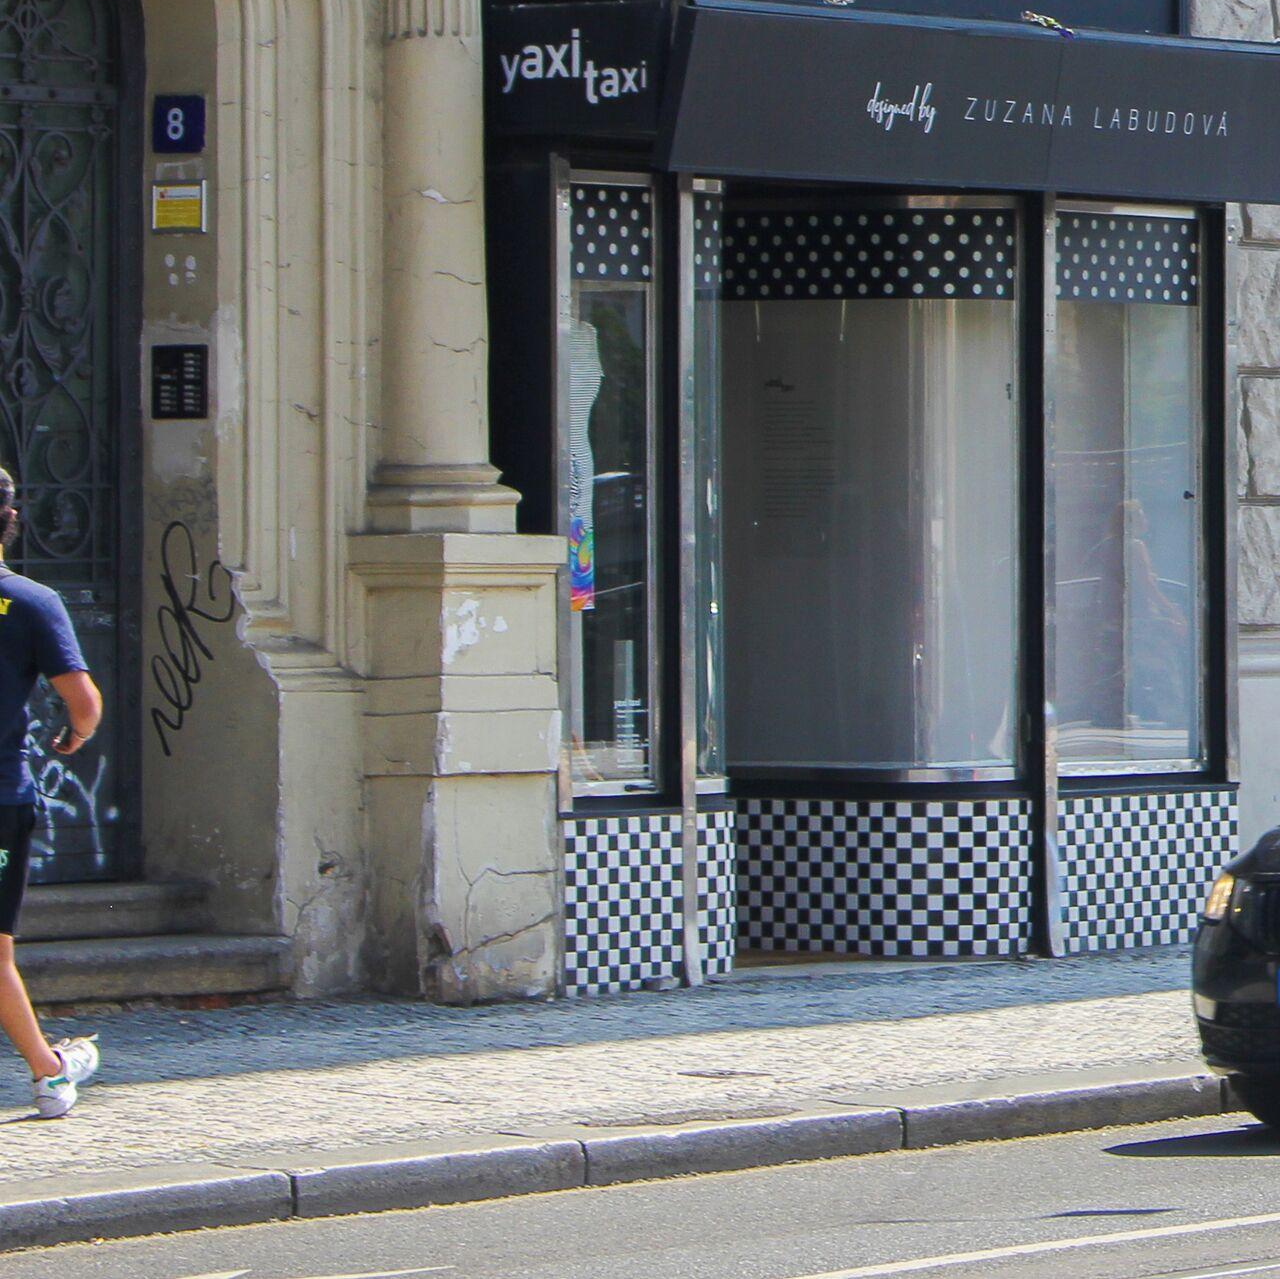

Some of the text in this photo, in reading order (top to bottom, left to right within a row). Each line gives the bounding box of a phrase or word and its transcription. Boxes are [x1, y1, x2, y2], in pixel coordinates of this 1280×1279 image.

[501, 28, 581, 94] yaxi
[583, 60, 647, 104] taxi
[167, 107, 184, 140] 8
[867, 81, 1228, 137] designed by ZUZANA LABUDOVÁ
